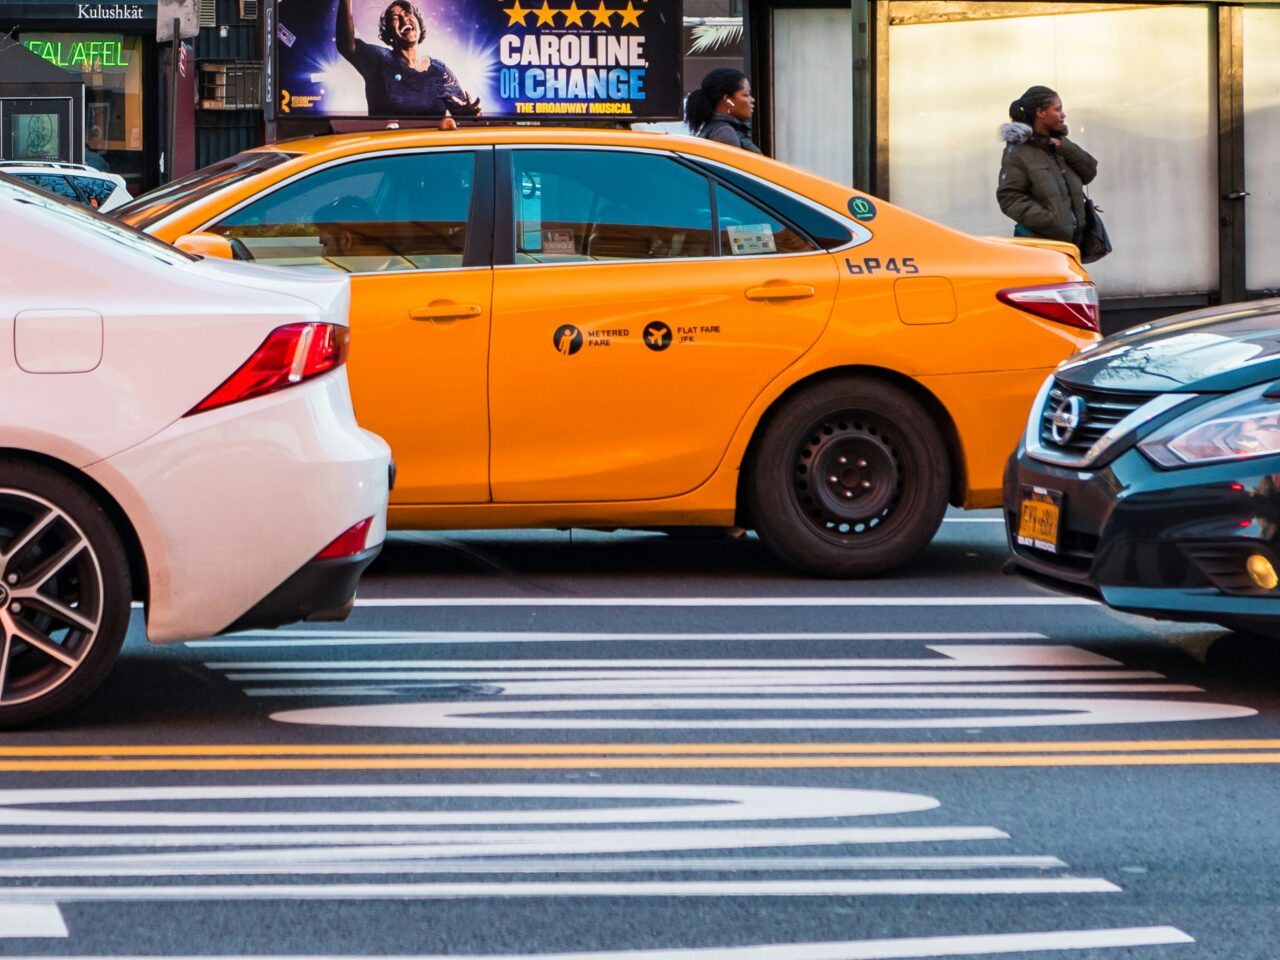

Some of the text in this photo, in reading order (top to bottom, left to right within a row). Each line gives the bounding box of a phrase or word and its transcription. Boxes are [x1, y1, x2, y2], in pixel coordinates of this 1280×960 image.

[77, 4, 144, 20] Kulushkät
[28, 41, 129, 66] FALAFEL
[499, 33, 650, 69] CAROLINE,
[500, 67, 646, 100] OR CHANGE
[515, 102, 633, 115] THE BROADWAY MUSICAL
[588, 329, 630, 338] METERED
[677, 325, 721, 334] FLAT FARE
[588, 338, 611, 347] FARE
[678, 335, 695, 343] JFK
